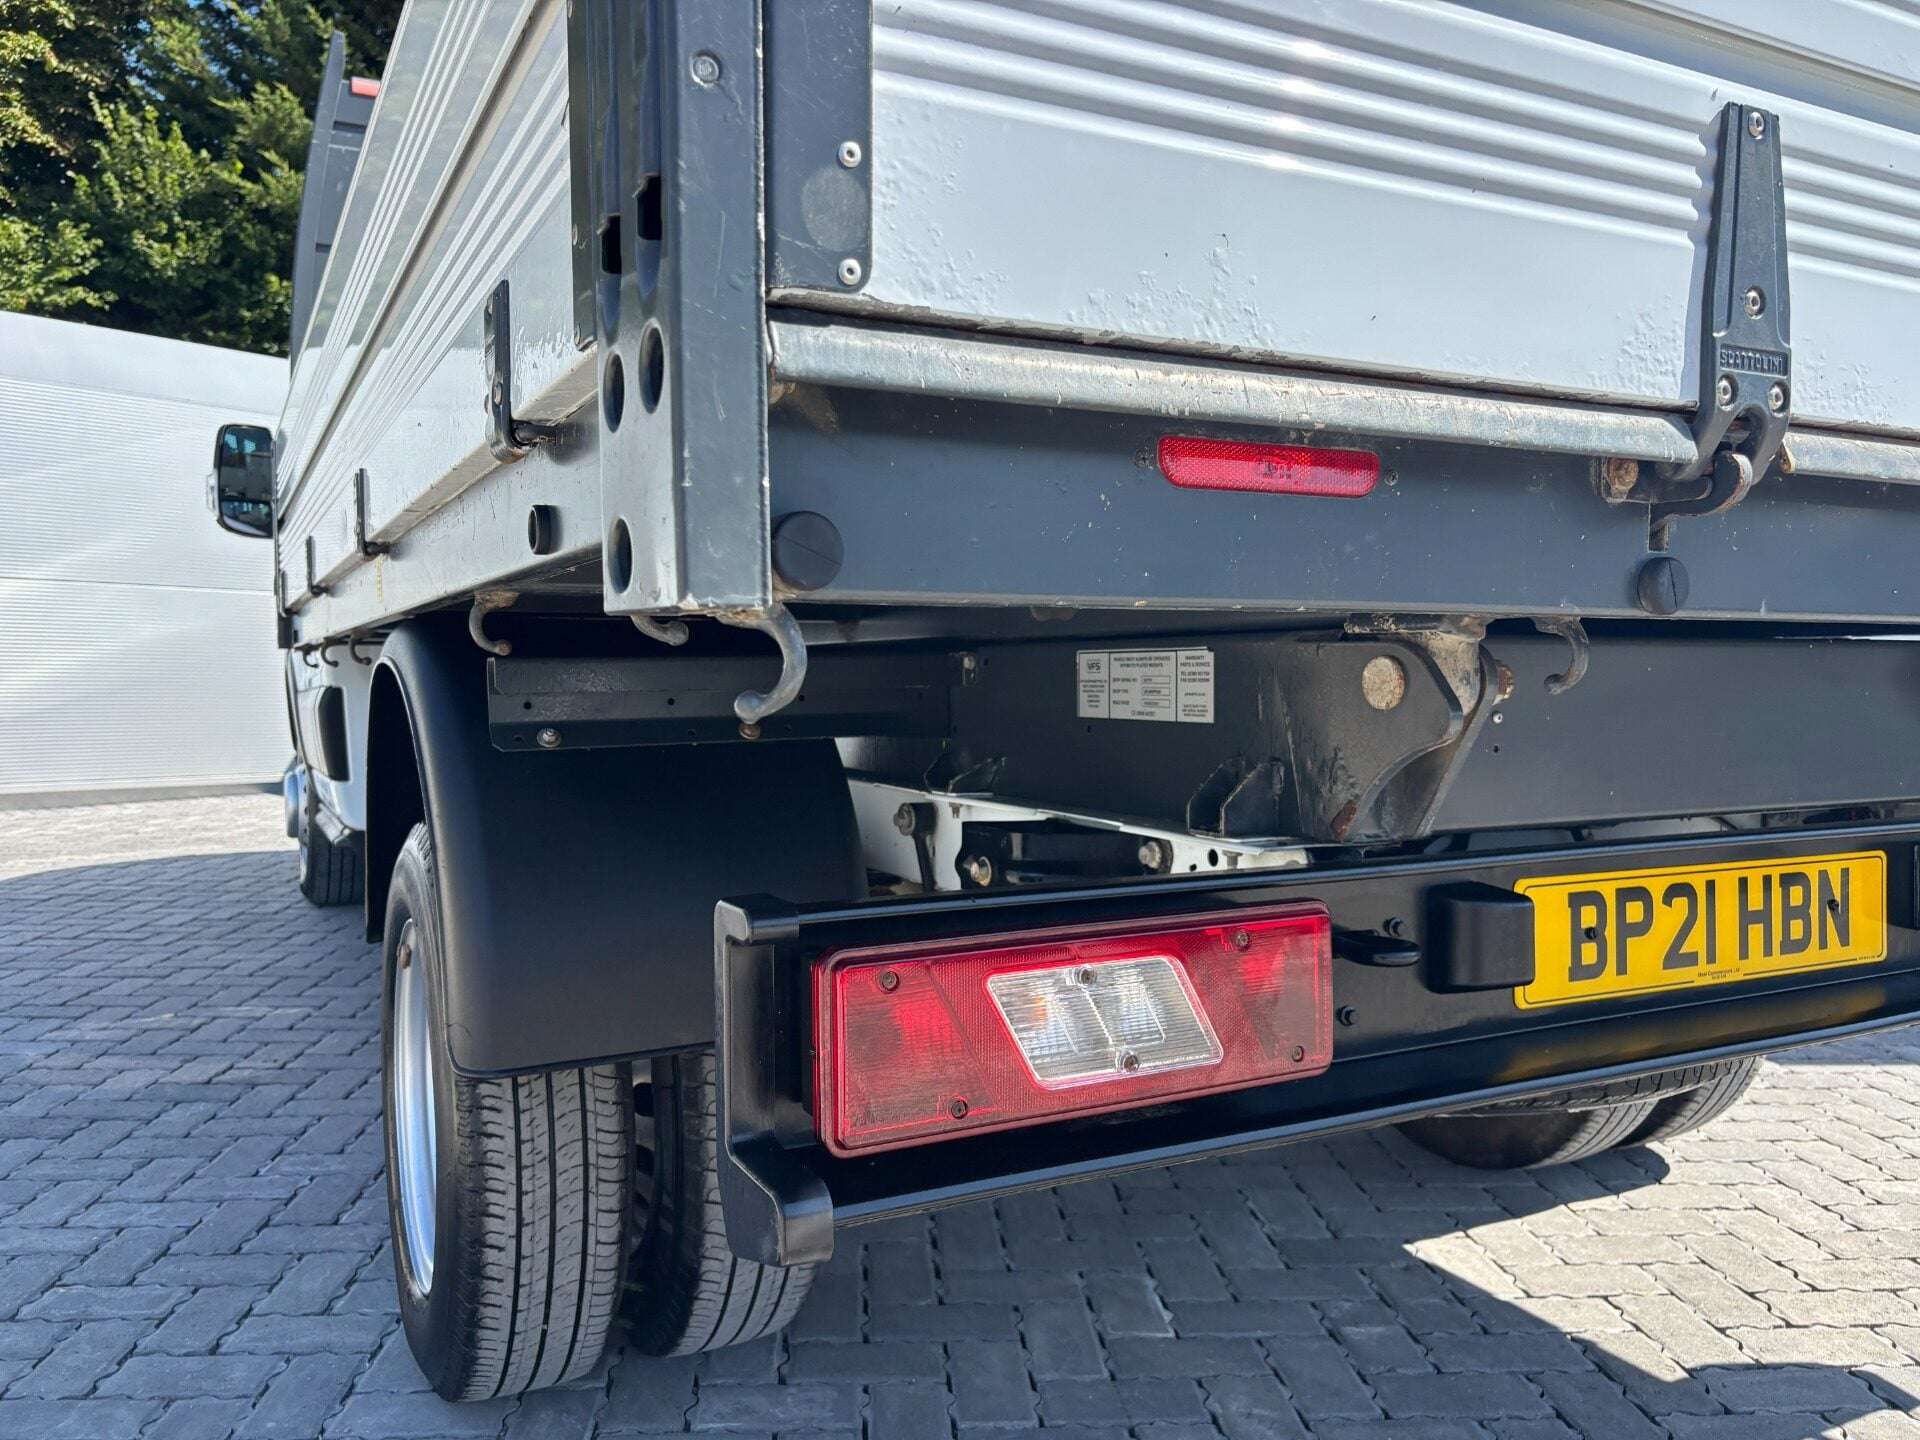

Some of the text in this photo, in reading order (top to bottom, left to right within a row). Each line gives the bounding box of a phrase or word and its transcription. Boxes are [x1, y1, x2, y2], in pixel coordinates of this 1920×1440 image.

[1720, 349, 1783, 375] SPATTOLINI
[1568, 867, 1850, 982] BP21 HBN
